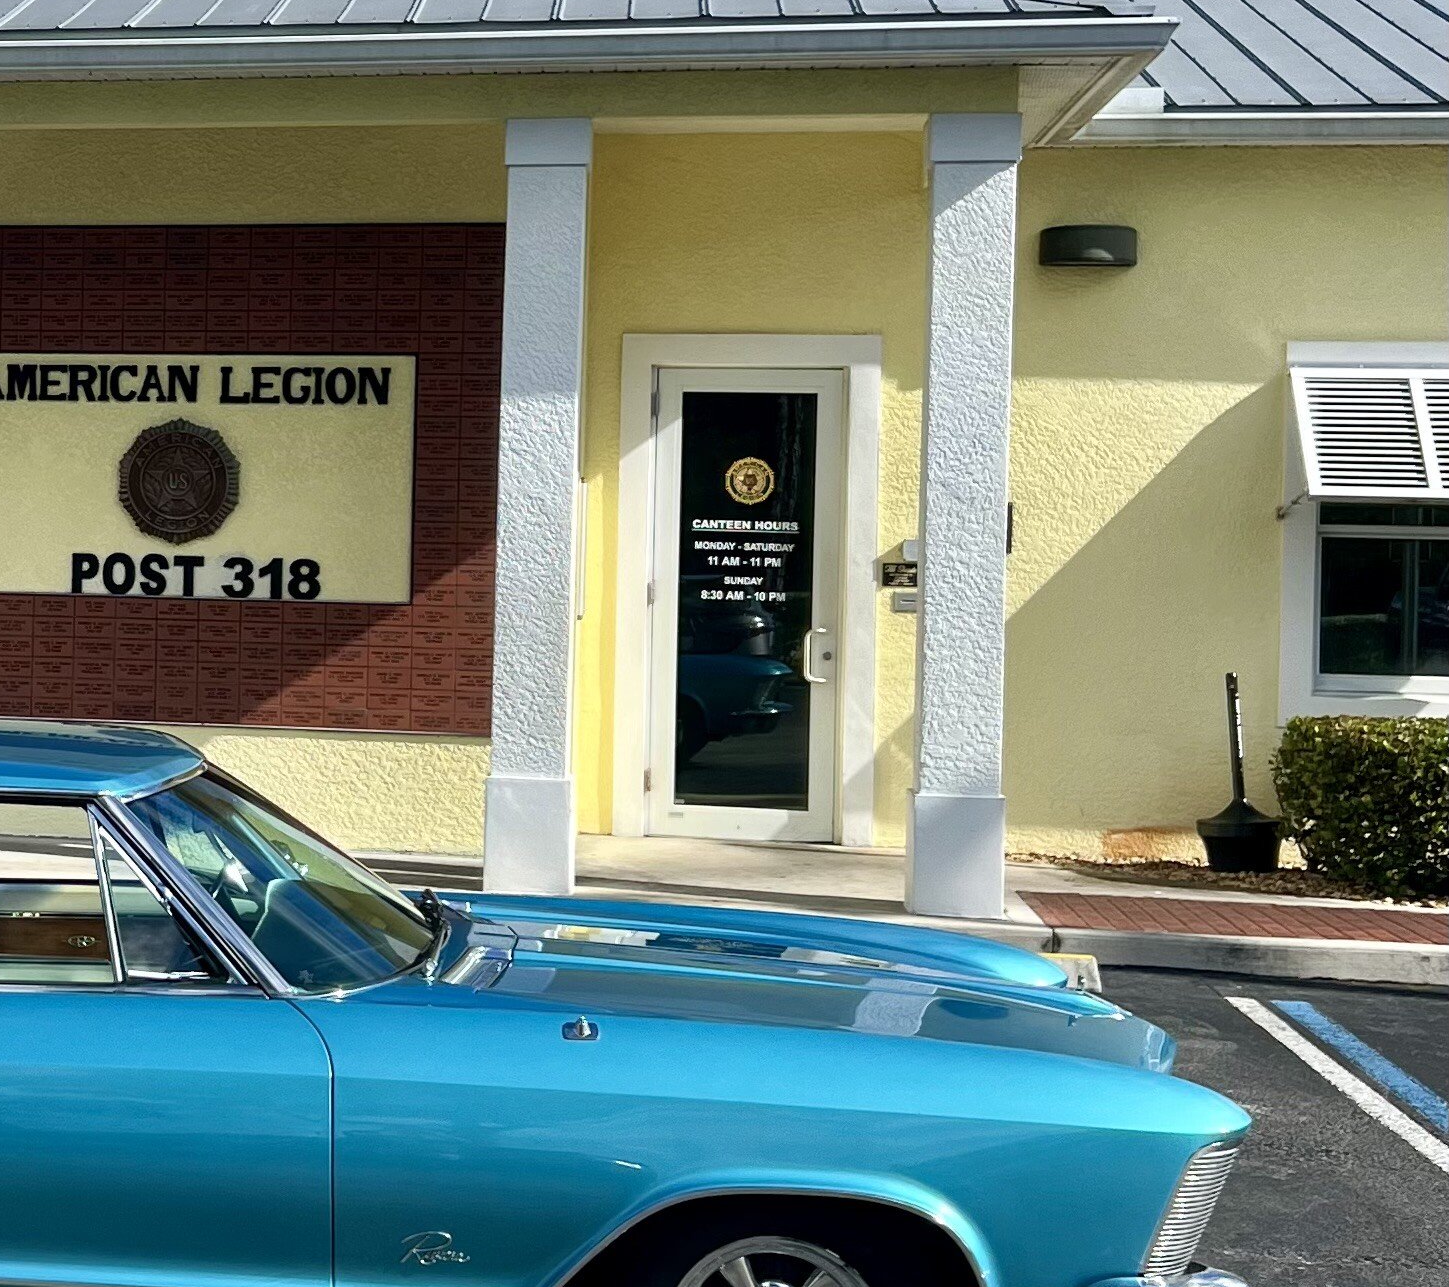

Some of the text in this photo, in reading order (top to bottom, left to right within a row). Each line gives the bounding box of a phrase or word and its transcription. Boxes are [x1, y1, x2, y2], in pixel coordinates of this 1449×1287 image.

[219, 366, 392, 405] LEGION
[135, 432, 223, 470] AMERICAN
[145, 510, 211, 530] LEGION
[692, 518, 799, 531] CANTEEN HOURS
[694, 540, 736, 551] MONDAY
[743, 542, 795, 552] SATURDAY
[707, 556, 718, 566] 11
[721, 556, 740, 566] AM
[750, 557, 761, 567] 11
[764, 557, 781, 567] PM
[71, 552, 322, 601] POST 318
[724, 576, 763, 585] SUNDAY
[701, 590, 723, 600] 8:30
[725, 590, 744, 601] AM
[754, 592, 765, 601] 10
[768, 592, 786, 602] PM
